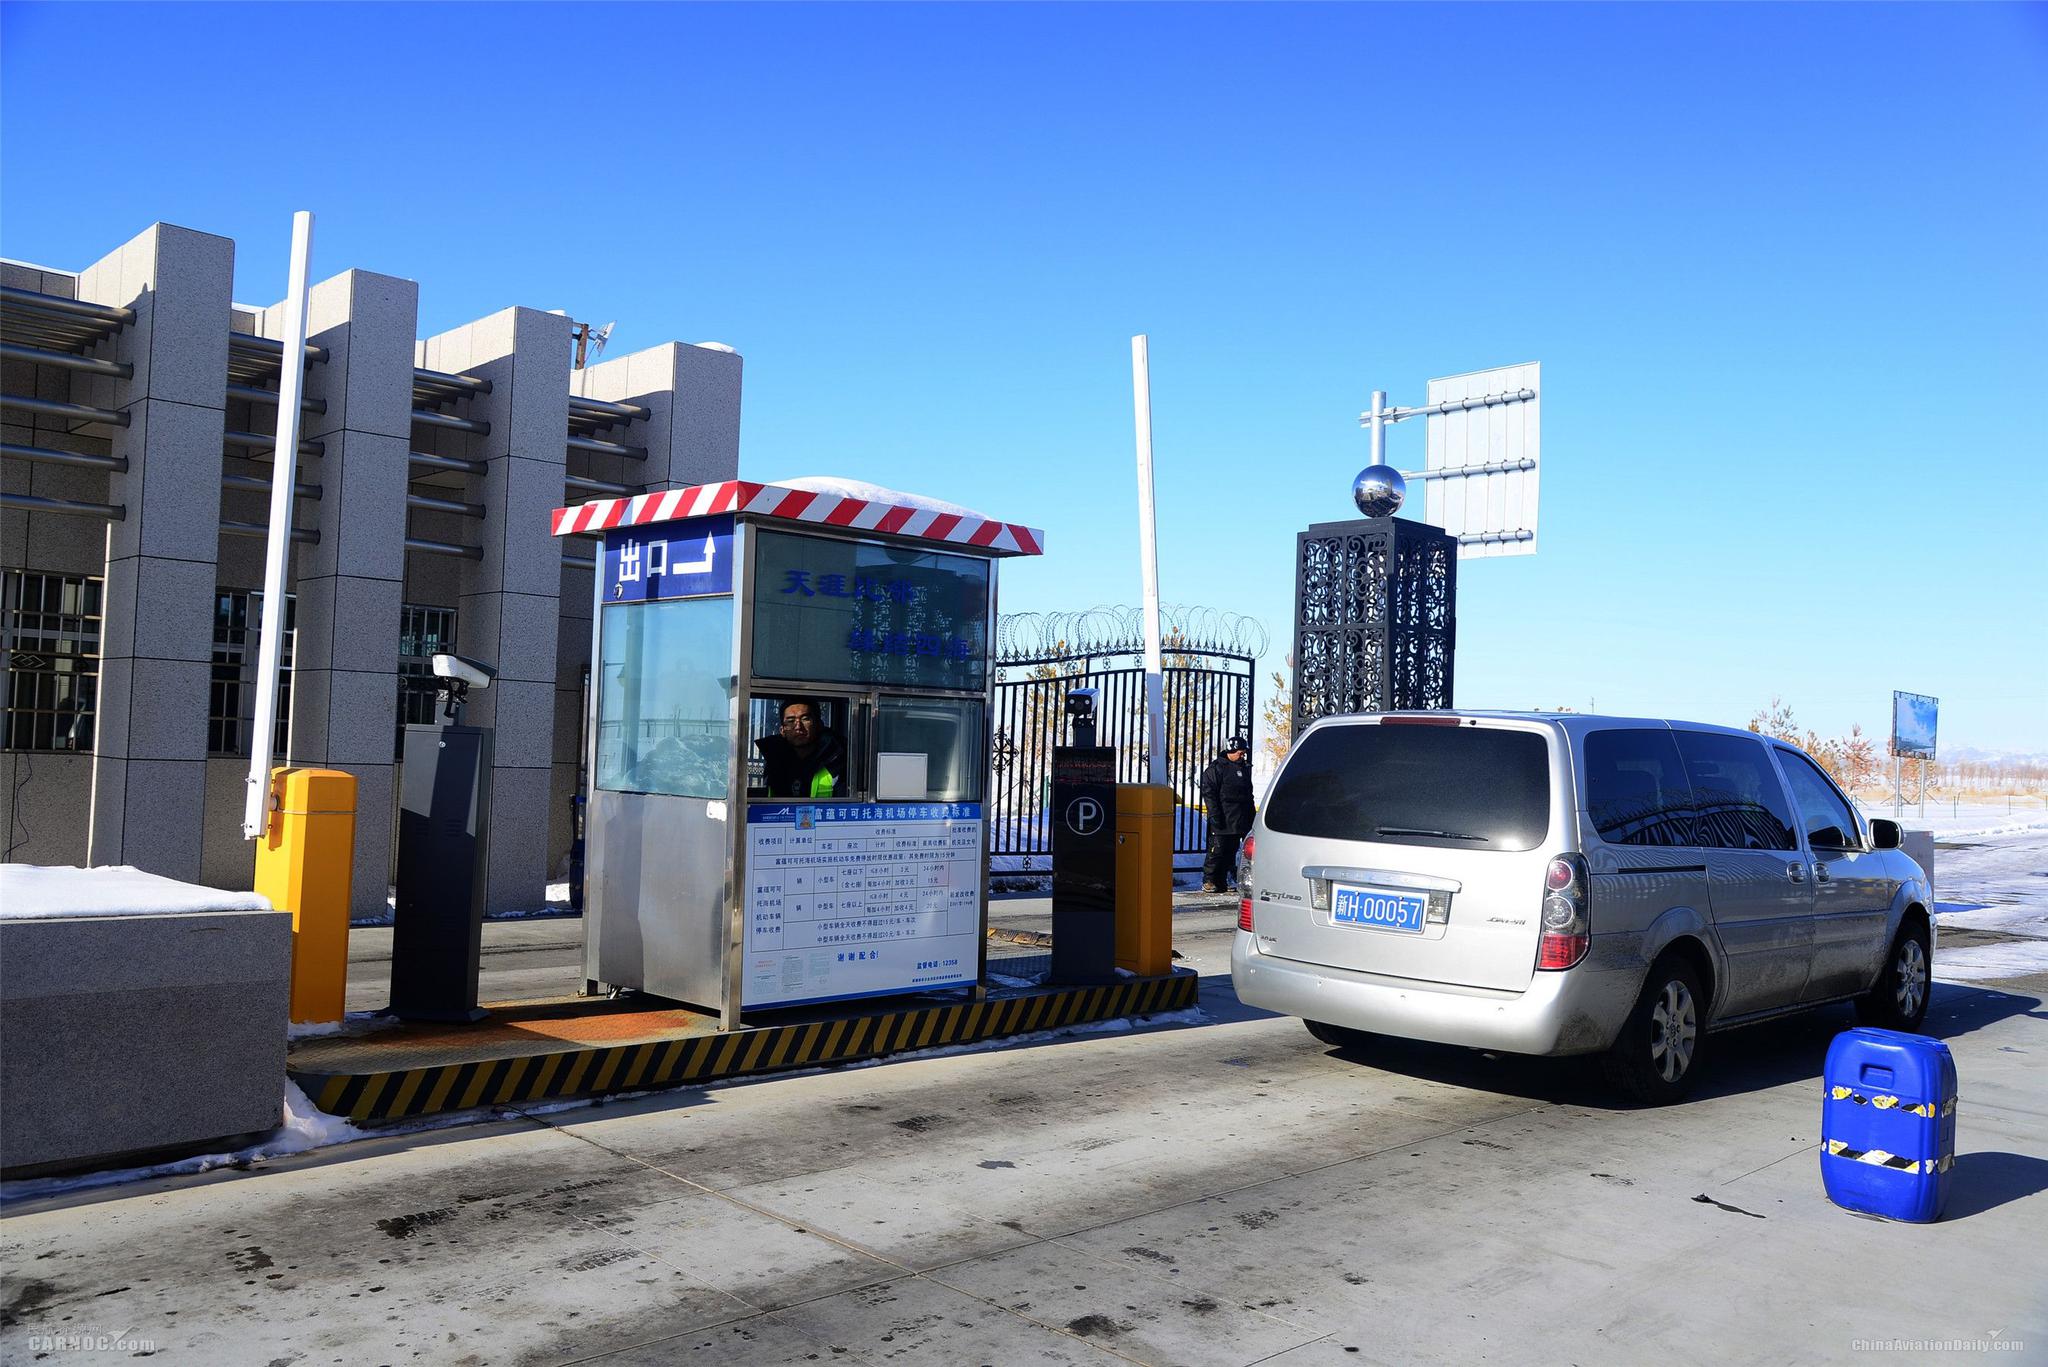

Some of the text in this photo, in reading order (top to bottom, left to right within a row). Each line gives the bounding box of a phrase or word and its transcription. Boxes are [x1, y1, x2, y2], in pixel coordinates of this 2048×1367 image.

[619, 539, 668, 582] 出口
[815, 807, 971, 820] 富蕴可可托海机场停车收费标准
[1079, 802, 1097, 831] P
